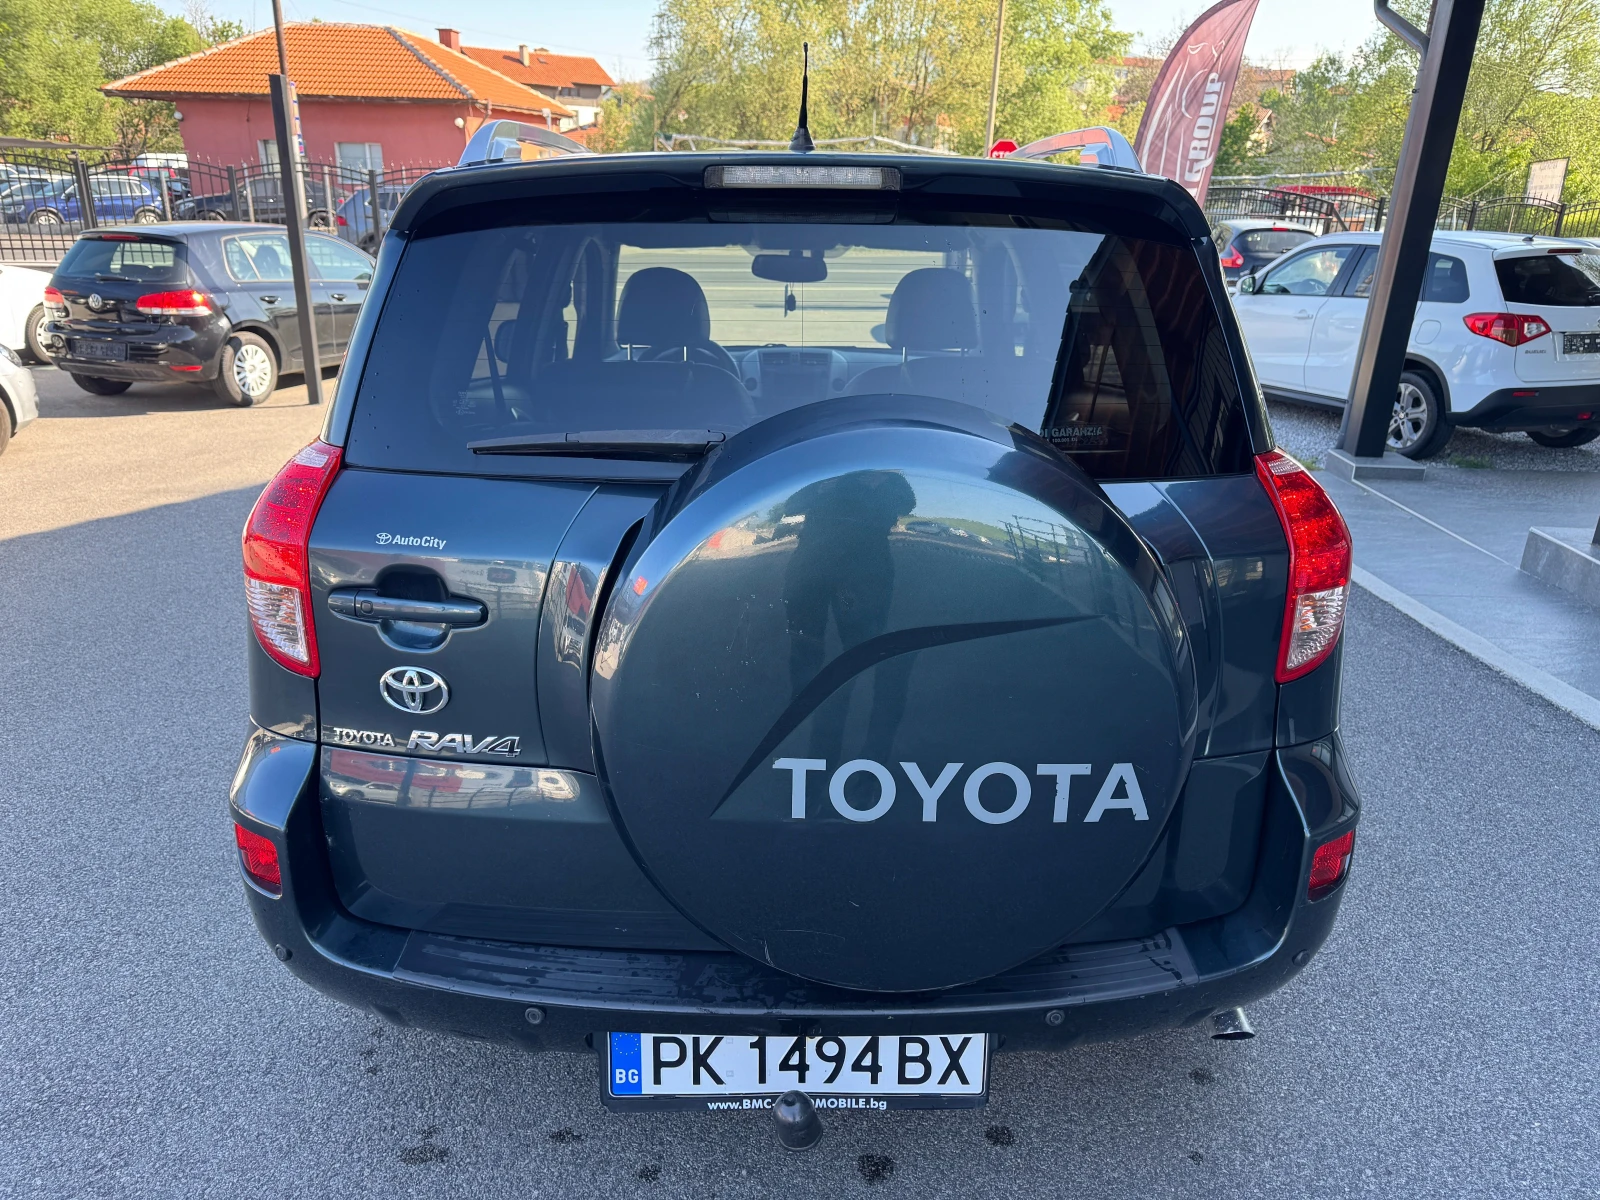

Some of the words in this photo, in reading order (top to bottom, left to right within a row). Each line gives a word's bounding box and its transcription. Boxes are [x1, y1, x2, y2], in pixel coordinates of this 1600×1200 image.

[1184, 72, 1222, 182] GROUP
[333, 727, 395, 747] TOYOTA
[407, 729, 521, 757] RAV4
[772, 757, 1149, 825] TOYOTA
[615, 1068, 639, 1084] BG
[652, 1036, 725, 1086] PK
[749, 1035, 883, 1085] 1494
[897, 1036, 973, 1086] BX
